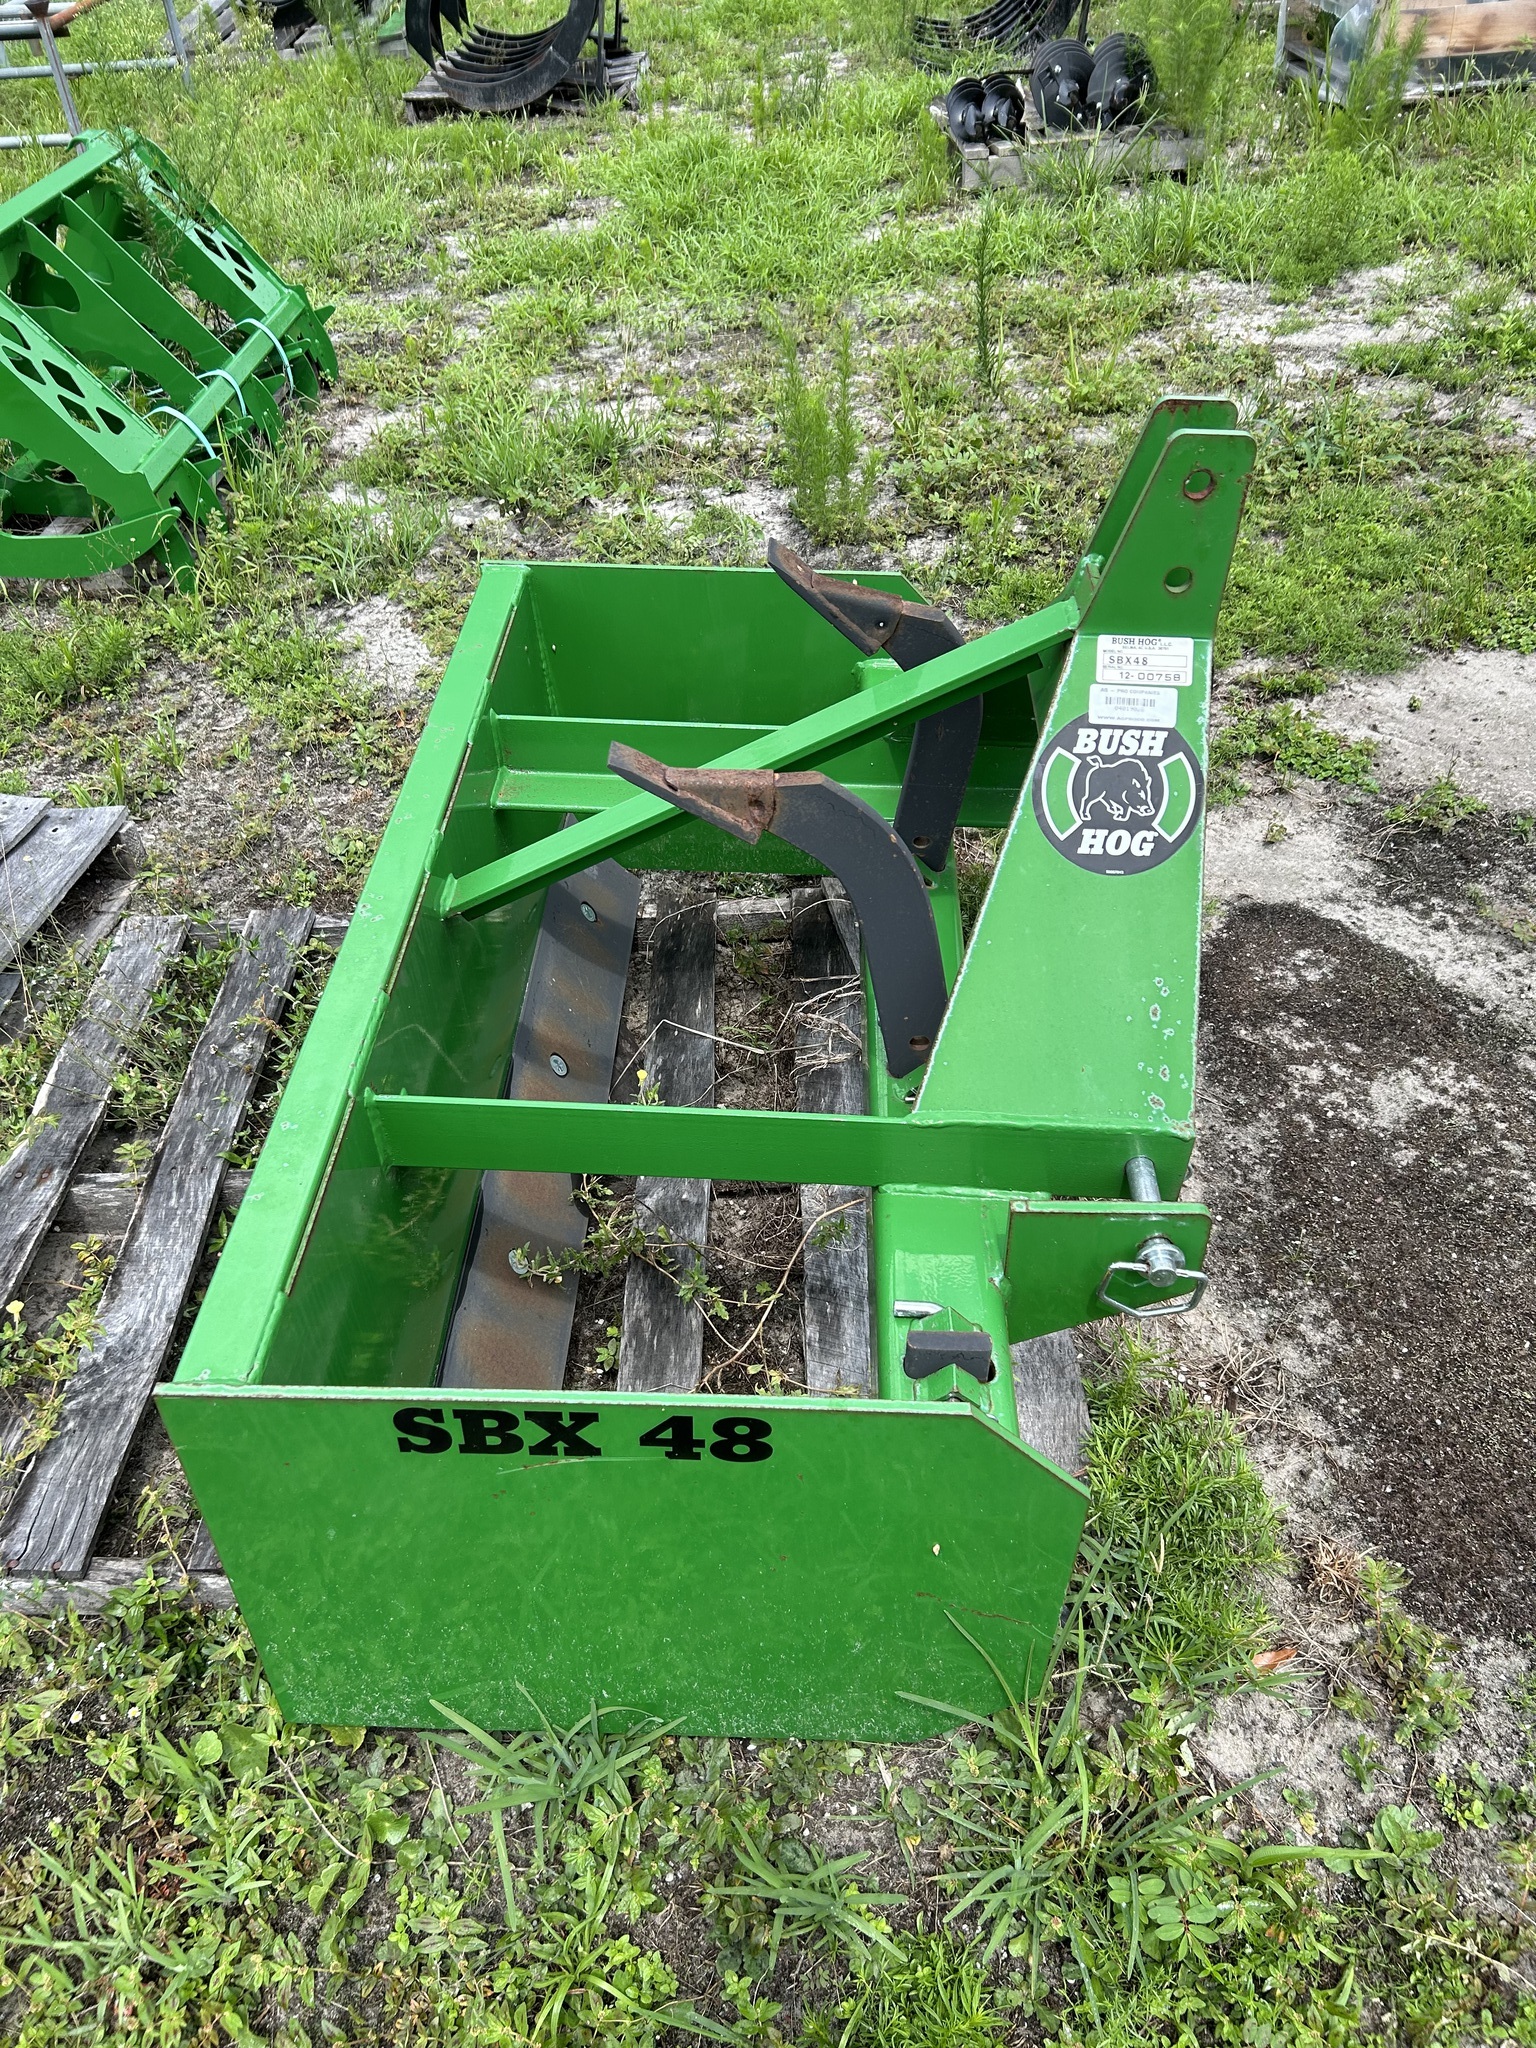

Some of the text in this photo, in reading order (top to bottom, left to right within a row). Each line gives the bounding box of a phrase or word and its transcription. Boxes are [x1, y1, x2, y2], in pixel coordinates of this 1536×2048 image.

[1112, 637, 1135, 645] BUSH
[1109, 656, 1148, 665] SBX48
[1072, 727, 1170, 757] BUSH
[1077, 829, 1159, 857] HOG
[392, 1407, 774, 1463] SBX 48
